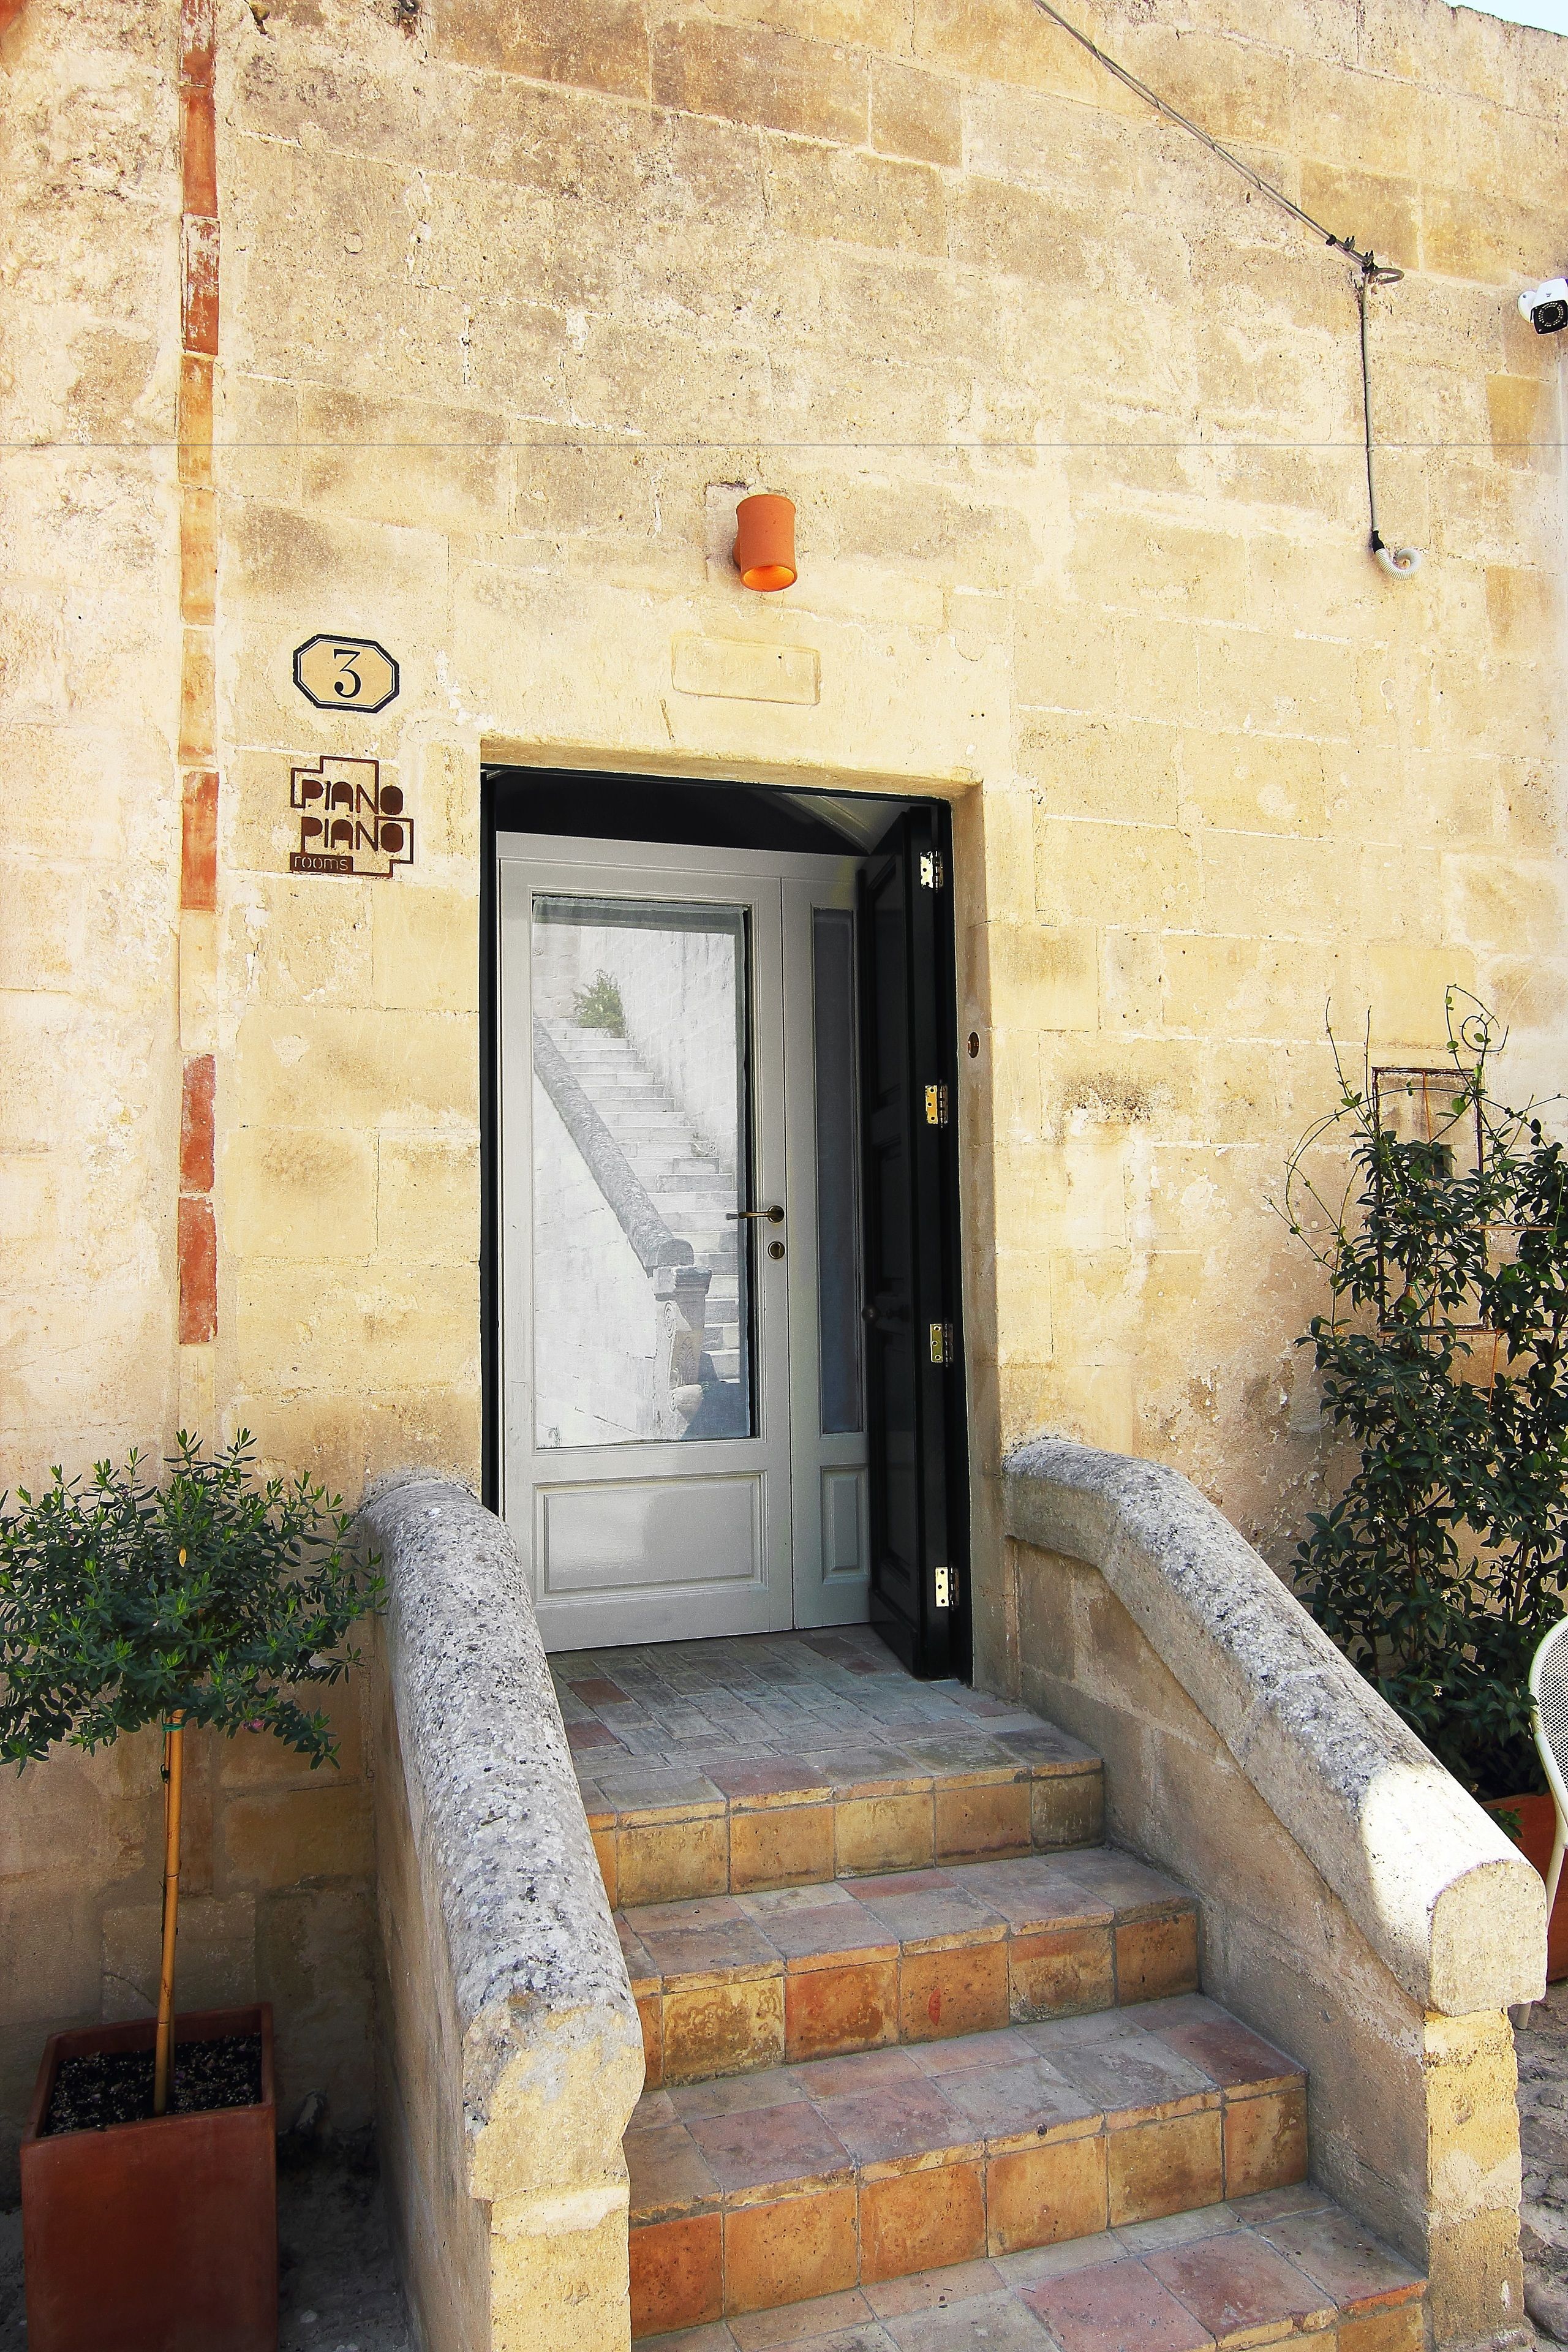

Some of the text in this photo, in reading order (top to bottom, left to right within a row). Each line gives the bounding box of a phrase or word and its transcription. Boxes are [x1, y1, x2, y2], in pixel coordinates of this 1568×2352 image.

[334, 649, 361, 698] 3
[302, 779, 404, 815] PIANO
[301, 816, 404, 853] PIANO
[293, 855, 349, 871] rooms
